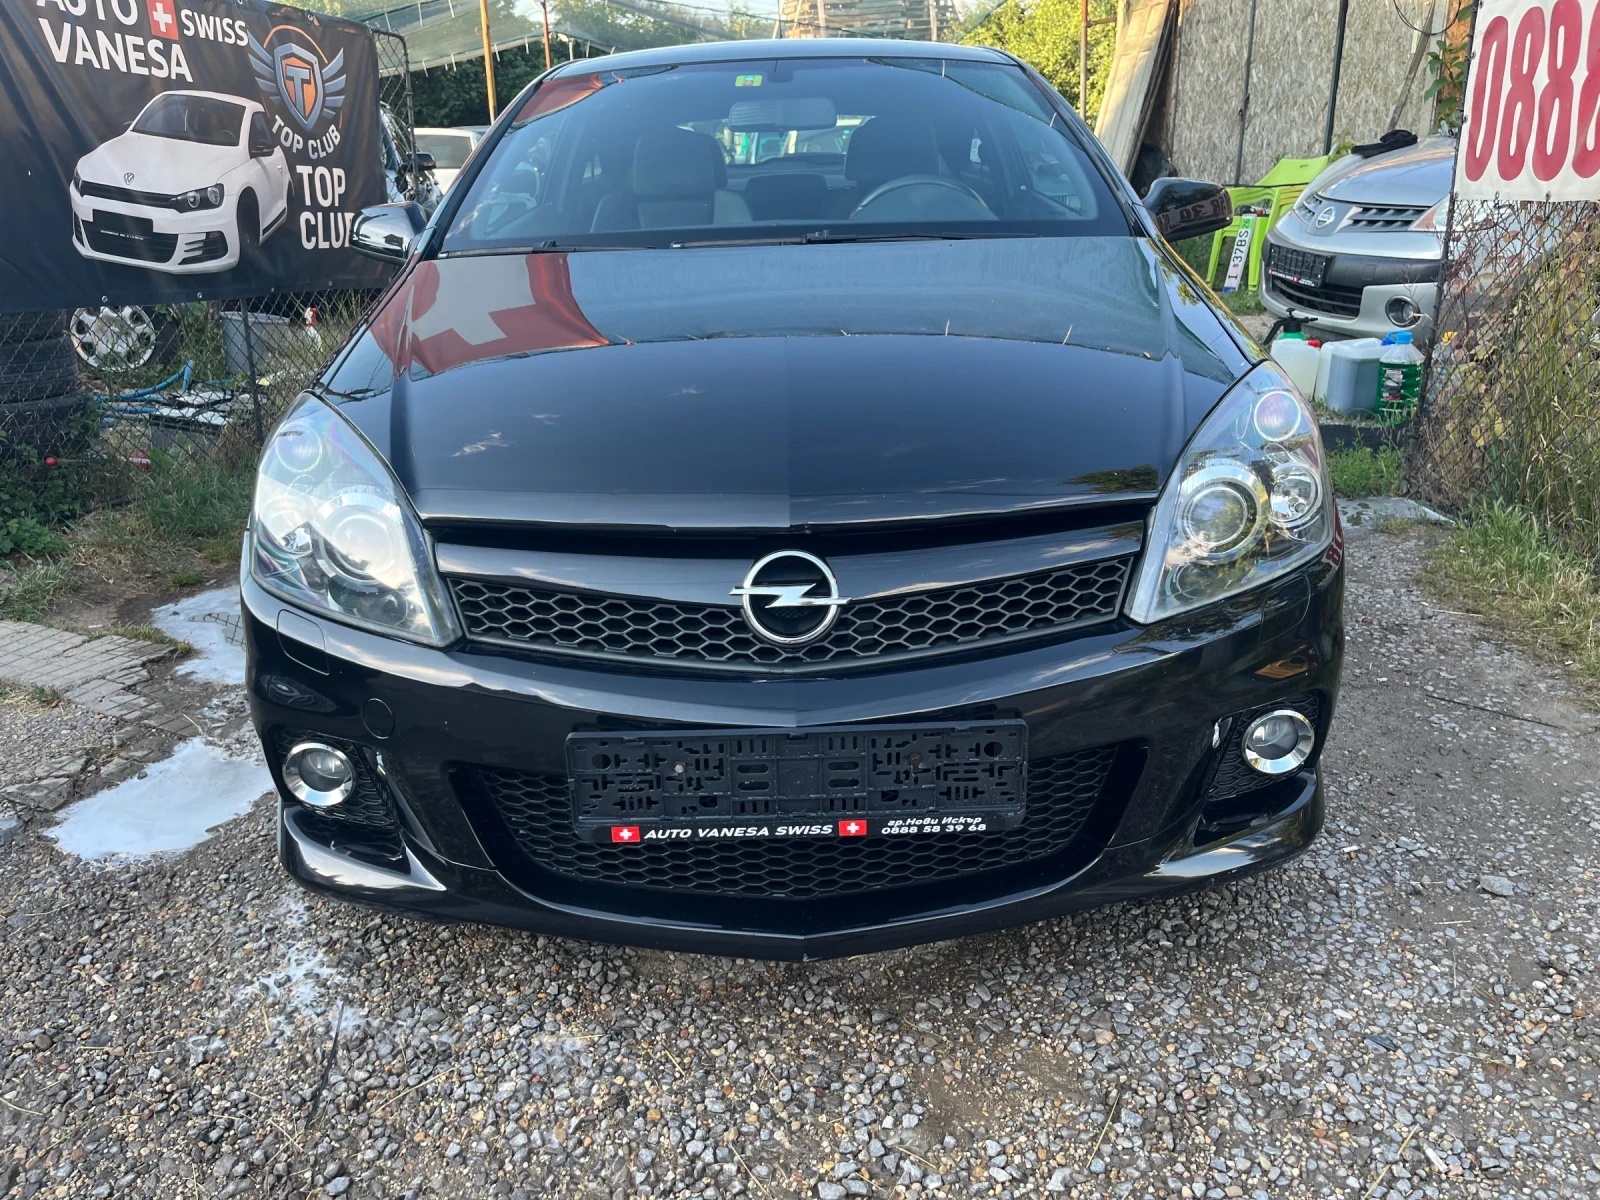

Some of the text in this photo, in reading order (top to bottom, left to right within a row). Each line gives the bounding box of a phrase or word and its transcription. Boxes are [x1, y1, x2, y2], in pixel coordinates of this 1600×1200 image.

[180, 9, 249, 47] SWISS
[38, 17, 194, 83] VANESA
[270, 114, 342, 160] TOP CLUB
[296, 165, 346, 208] TOP
[644, 825, 834, 840] AUTO VANESA SWISS
[881, 823, 987, 835] 0888 58 39 68
[941, 816, 982, 824] Искър
